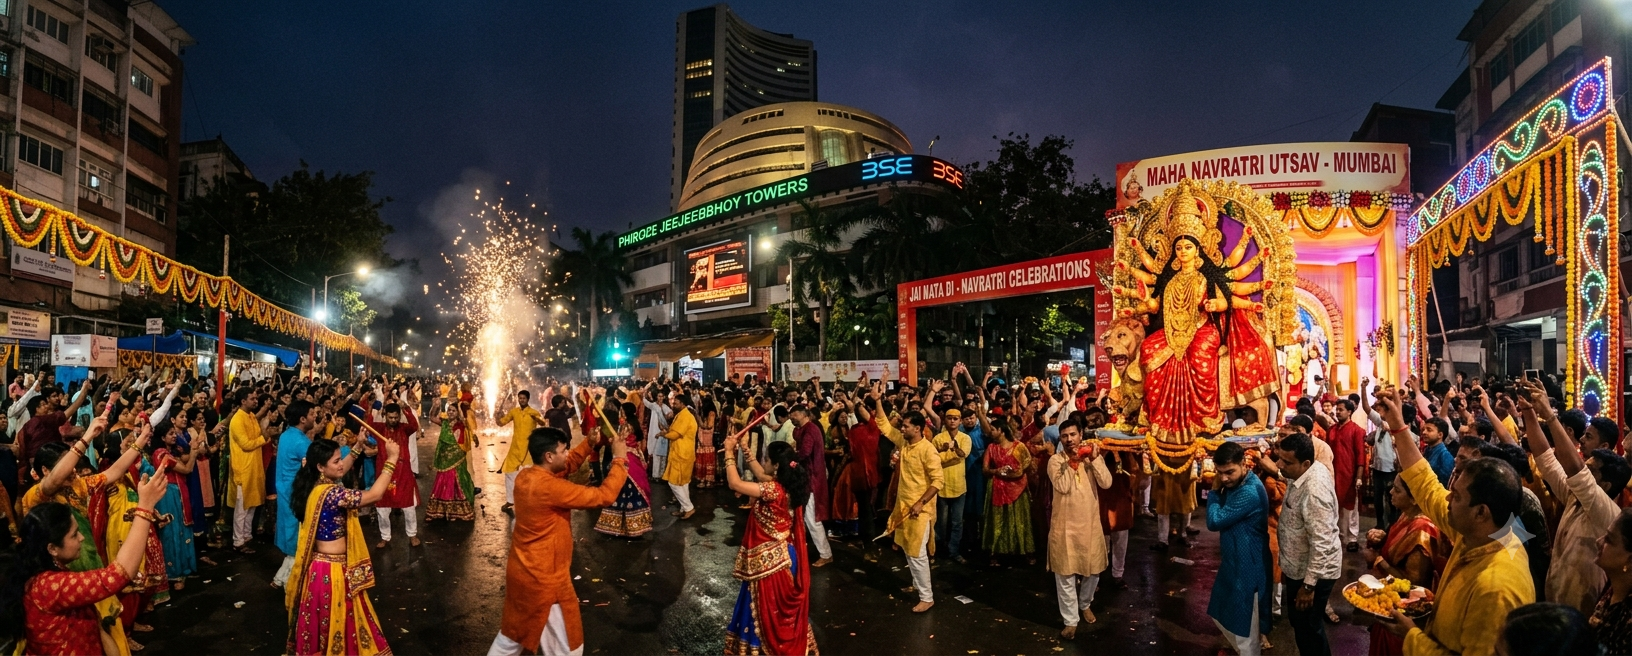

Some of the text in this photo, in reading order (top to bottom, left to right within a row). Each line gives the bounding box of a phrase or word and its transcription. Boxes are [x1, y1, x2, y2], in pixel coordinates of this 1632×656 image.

[862, 157, 912, 180] BSE
[933, 160, 963, 189] BSE
[1147, 163, 1187, 186] MAHA
[1192, 155, 1264, 181] NAVRATRI
[1269, 152, 1320, 174] UTSAV
[1333, 152, 1397, 174] MUMBAI
[745, 178, 808, 206] TOWERS
[909, 286, 922, 302] JAI
[961, 272, 1006, 294] NAVRATRI
[1009, 259, 1091, 287] CELEBRATIONS
